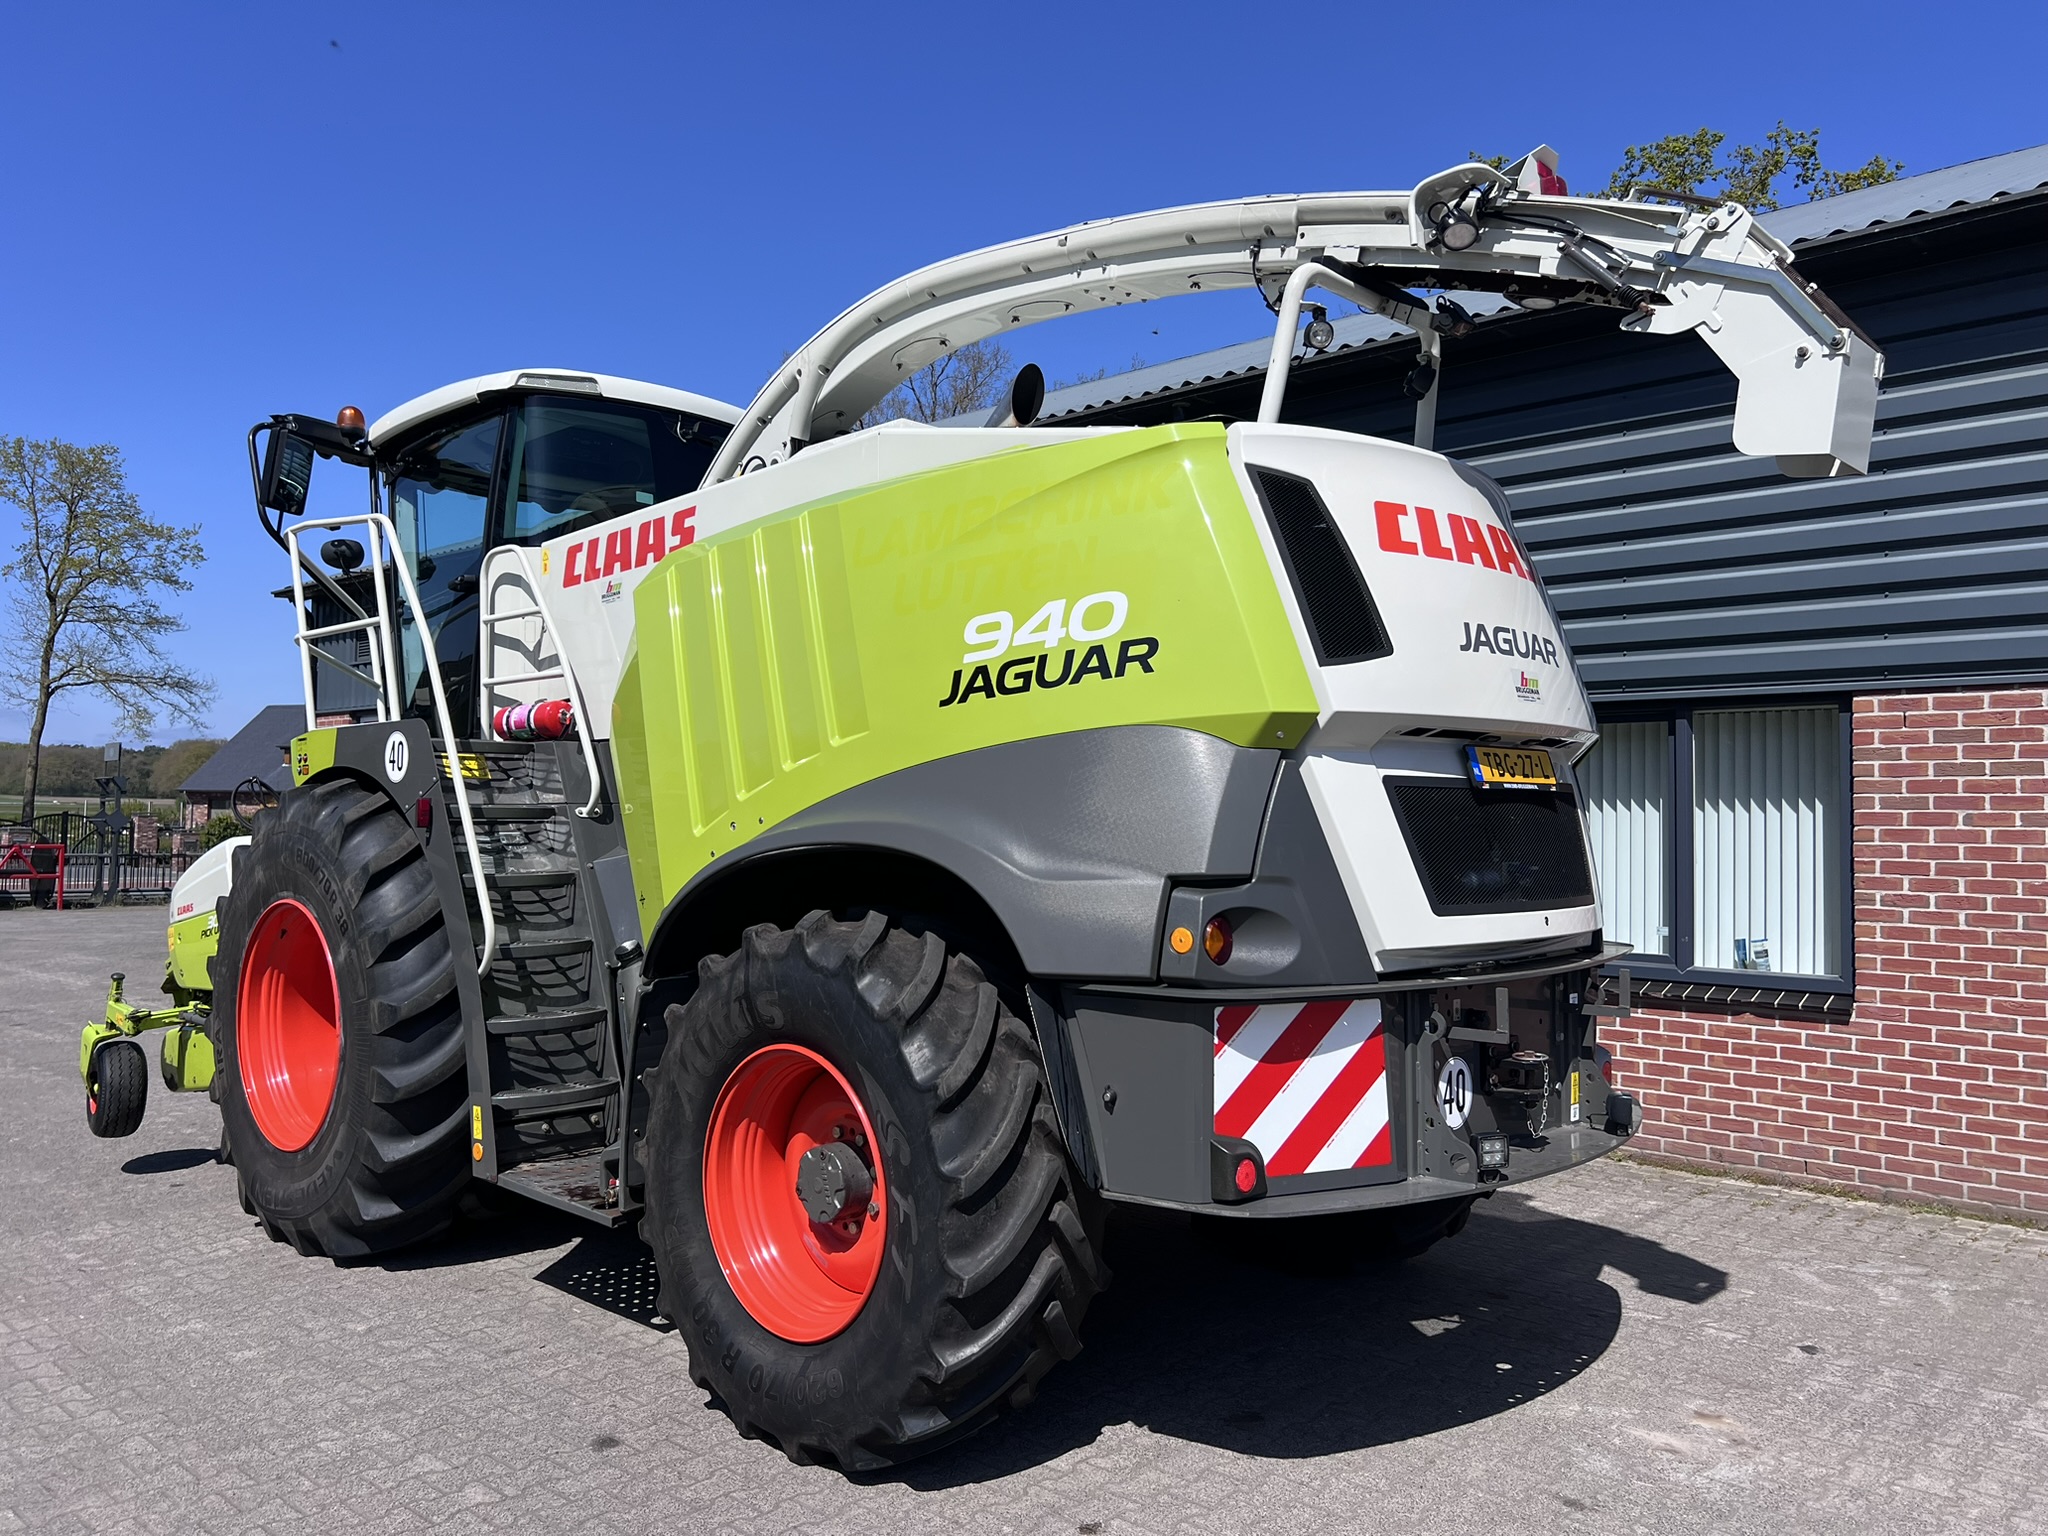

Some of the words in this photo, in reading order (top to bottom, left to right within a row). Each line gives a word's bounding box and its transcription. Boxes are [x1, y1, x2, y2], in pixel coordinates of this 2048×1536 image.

[562, 505, 697, 589] CLAAS
[1374, 500, 1536, 583] CLAA
[962, 591, 1128, 664] 940
[1459, 622, 1560, 668] JAGUAR
[938, 636, 1160, 708] JAGUAR
[1521, 671, 1538, 688] bm
[389, 740, 404, 772] 40
[1473, 767, 1481, 776] NL
[1482, 751, 1551, 780] TBG-27-L
[178, 903, 194, 916] CLAAS
[1443, 1068, 1466, 1115] 40
